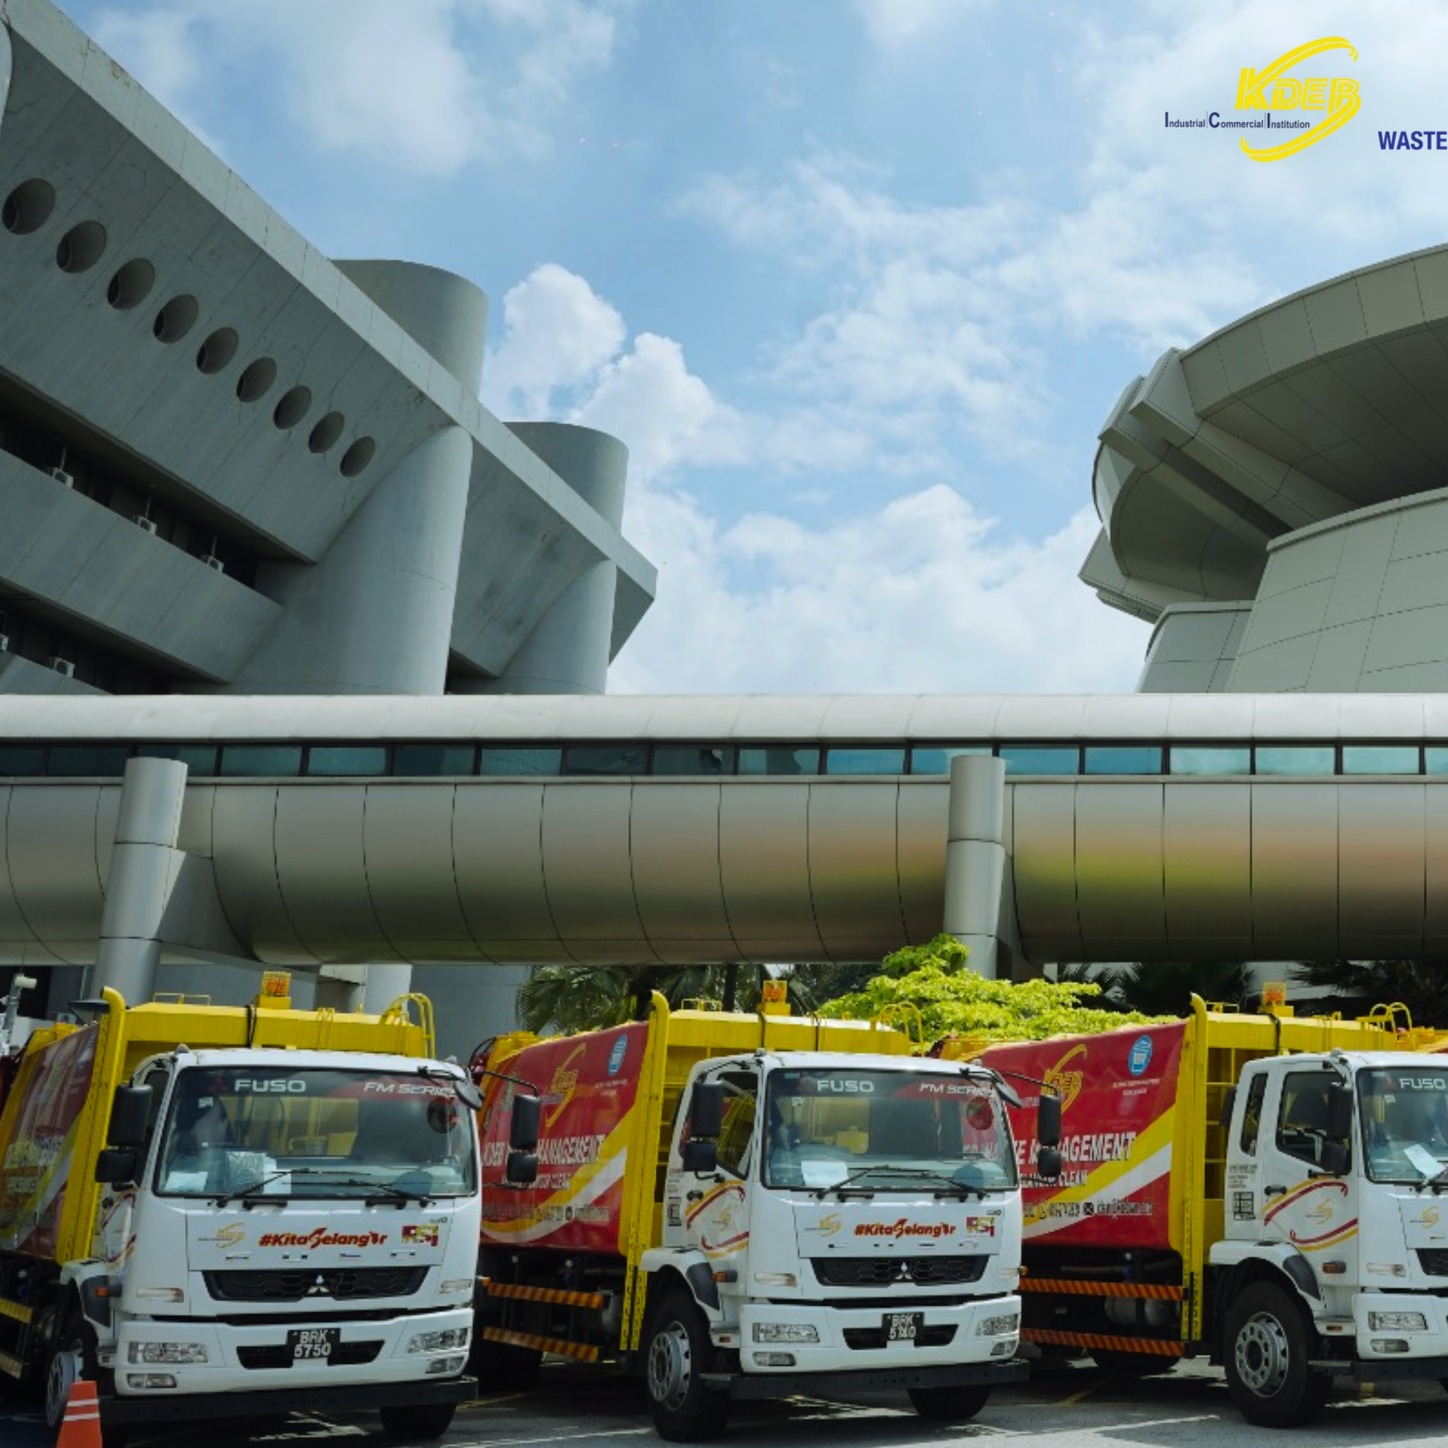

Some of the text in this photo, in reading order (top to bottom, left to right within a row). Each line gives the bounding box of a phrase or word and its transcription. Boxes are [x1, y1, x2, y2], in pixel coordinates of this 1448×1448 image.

[234, 1078, 307, 1093] FUSO
[363, 1081, 395, 1094] FM
[817, 1079, 875, 1093] FUSO
[1400, 1077, 1446, 1090] FUSO
[300, 1329, 328, 1345] BRK
